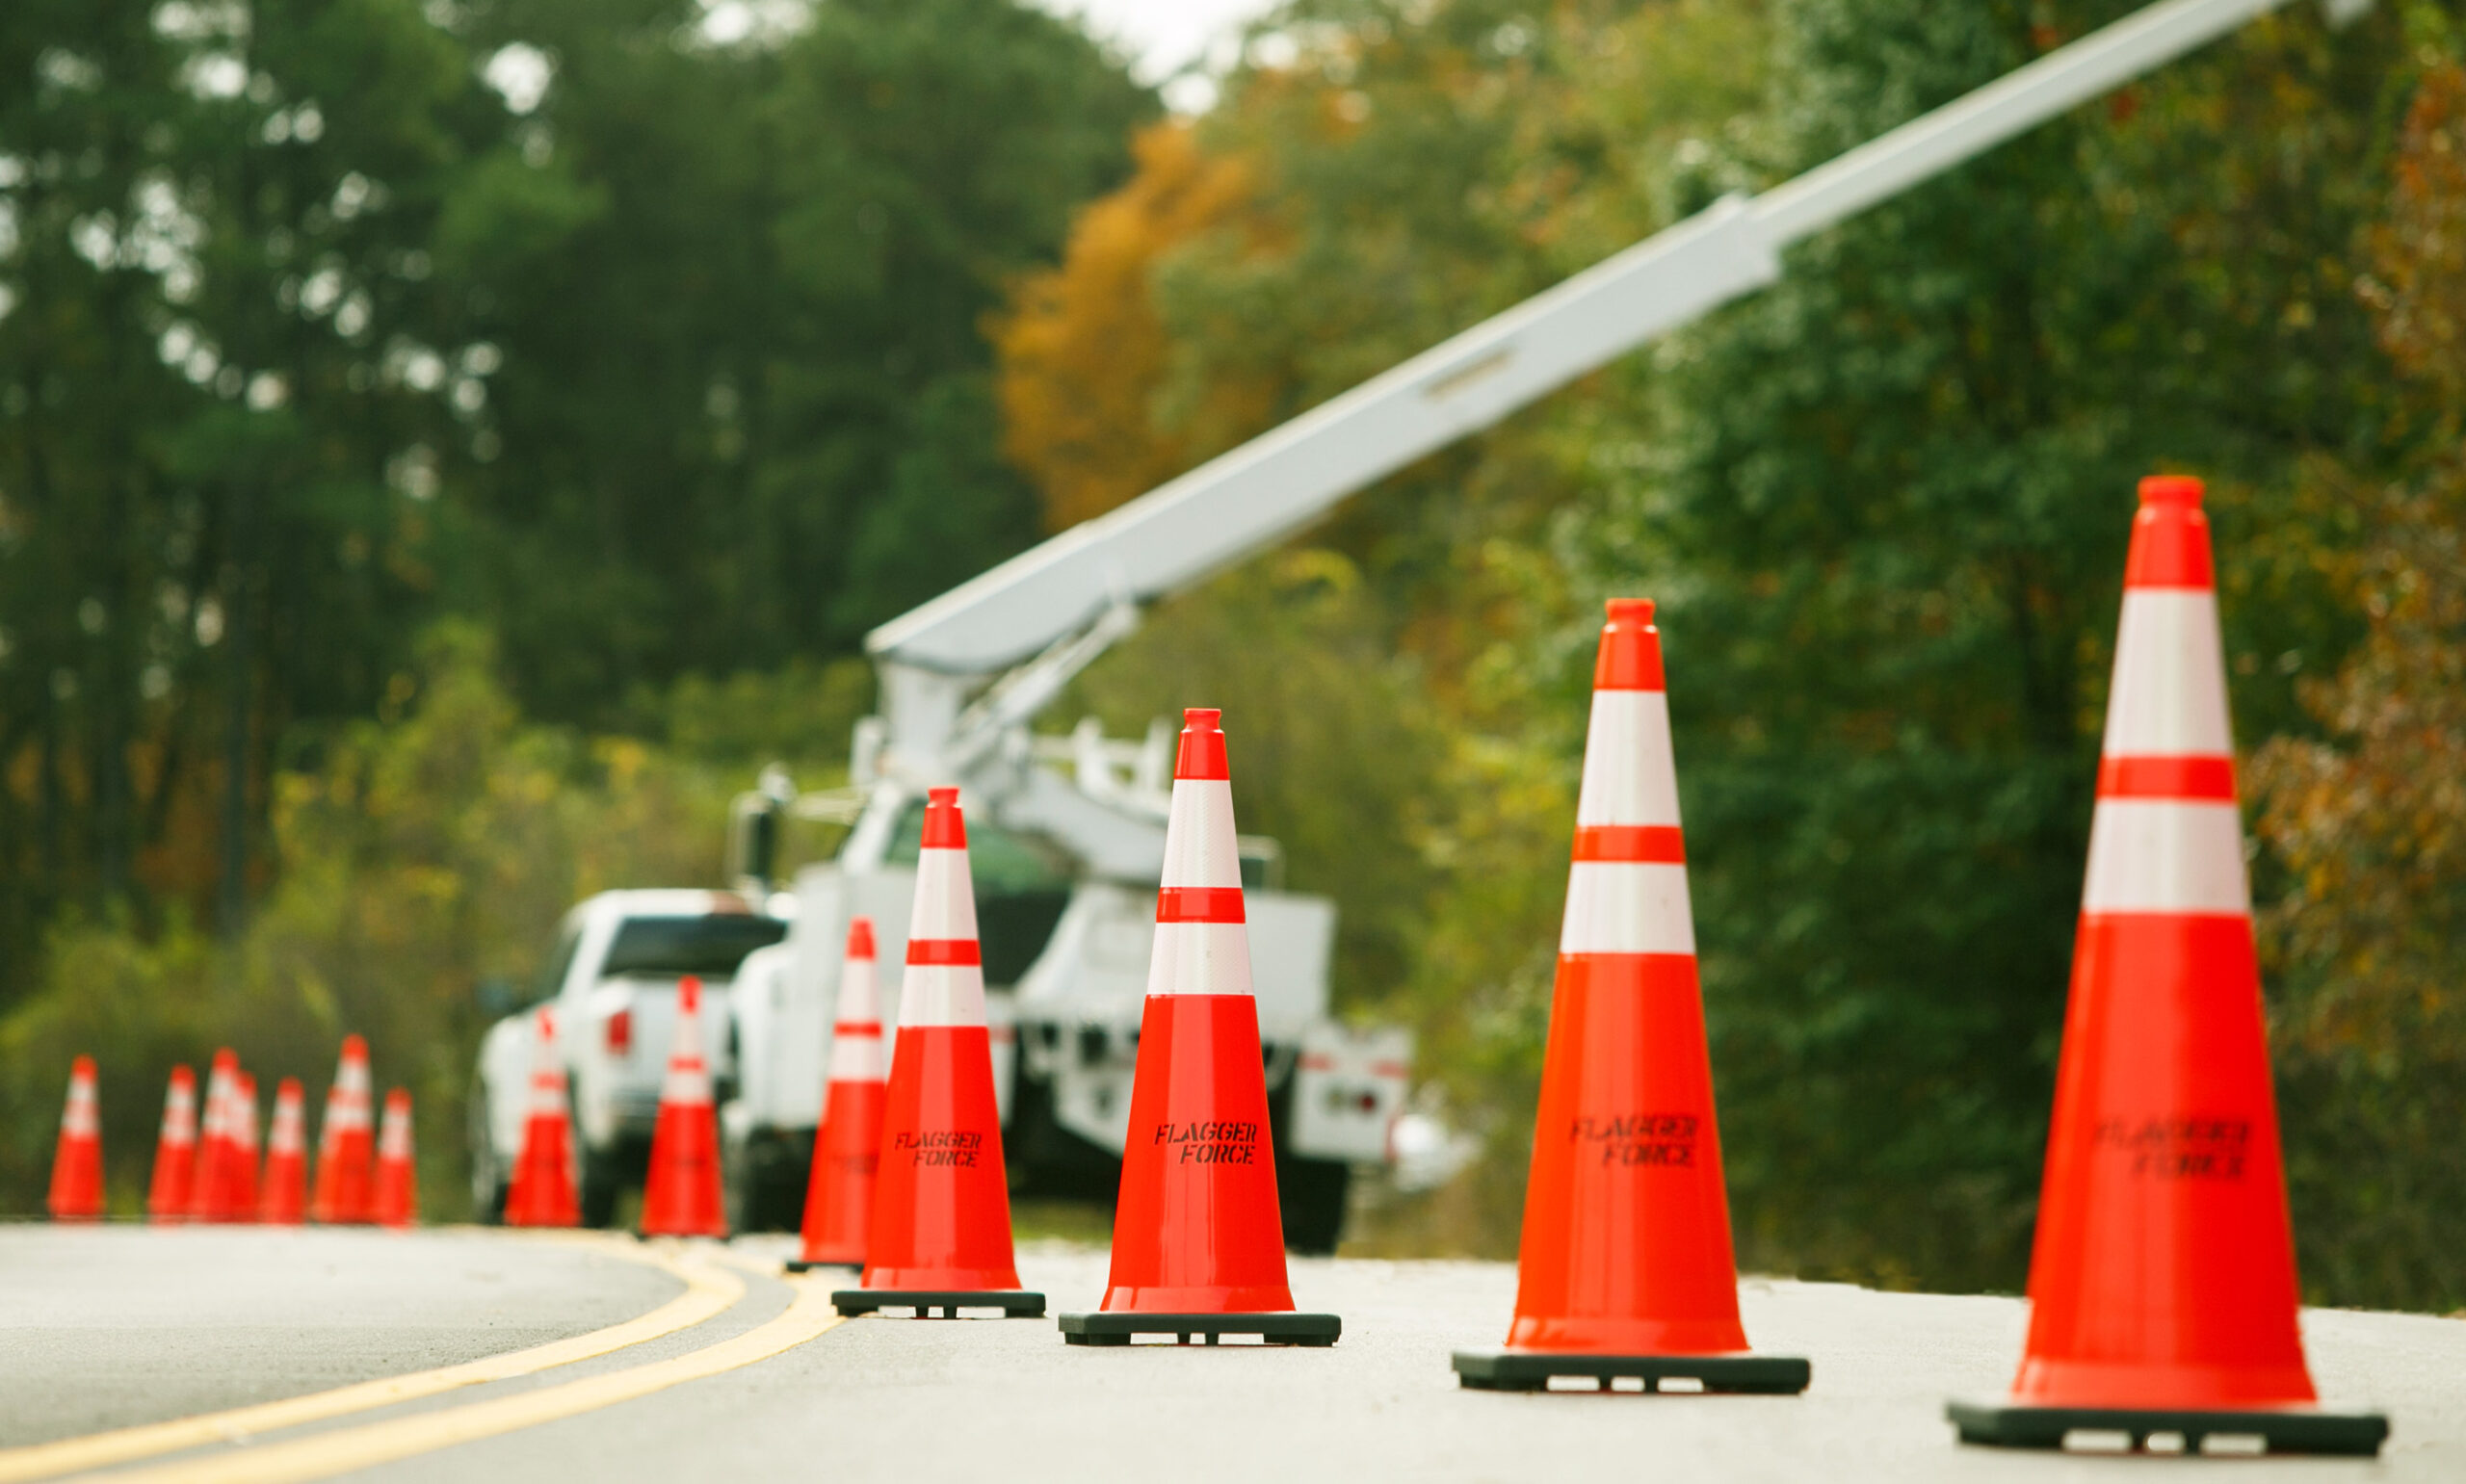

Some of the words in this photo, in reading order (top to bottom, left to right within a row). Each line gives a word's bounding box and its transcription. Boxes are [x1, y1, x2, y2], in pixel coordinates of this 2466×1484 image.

[895, 1132, 982, 1151] FLAGGER
[1154, 1122, 1256, 1144] FLAGGER
[913, 1150, 980, 1168] FORCE
[1180, 1144, 1255, 1164] FORCE
